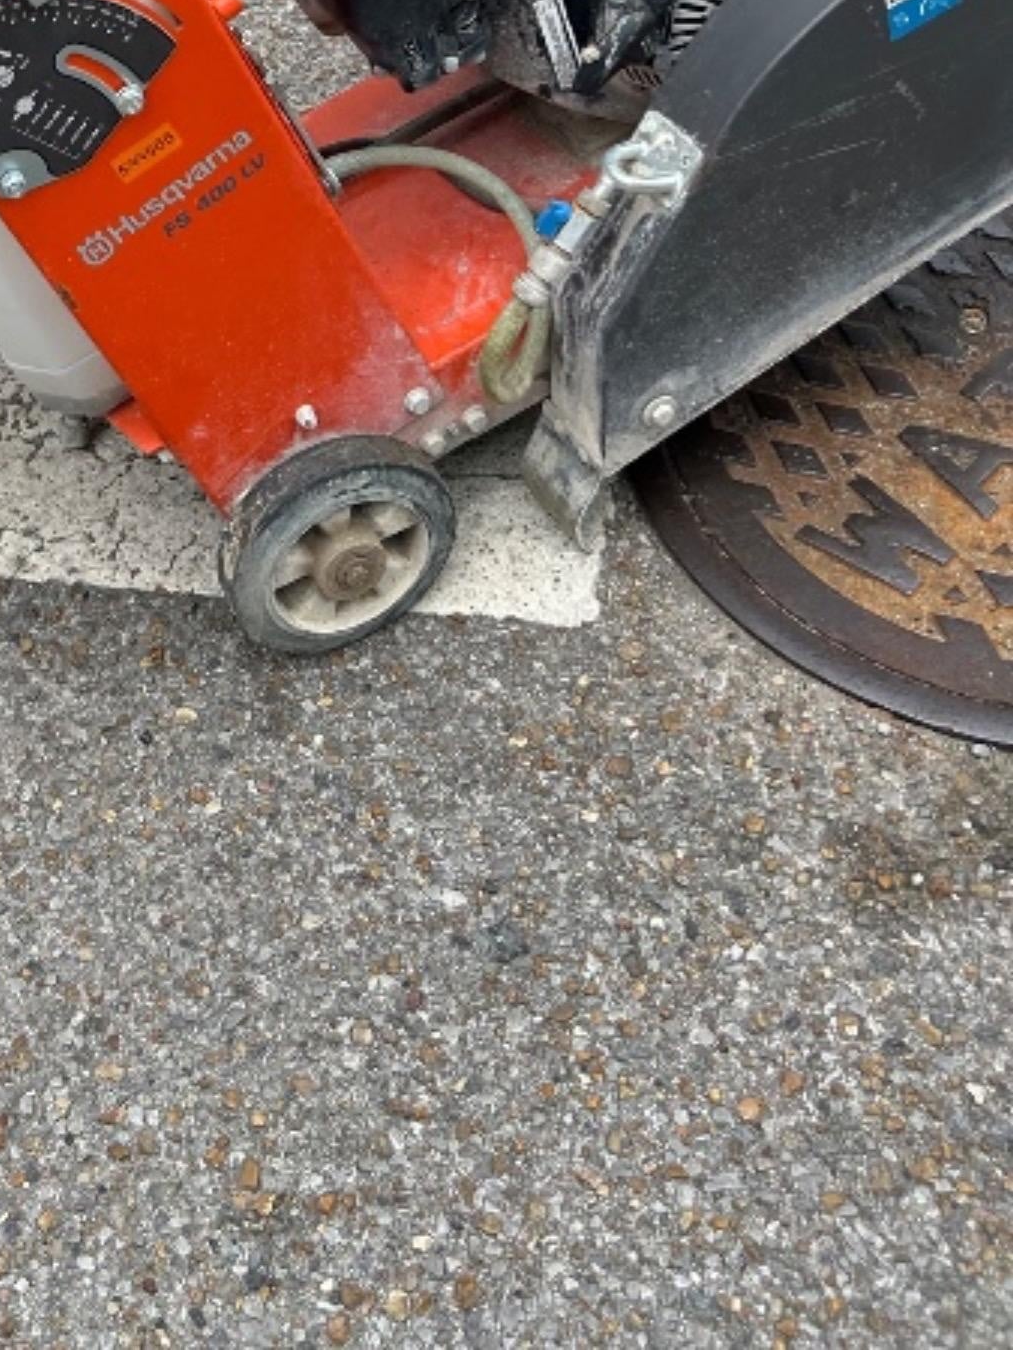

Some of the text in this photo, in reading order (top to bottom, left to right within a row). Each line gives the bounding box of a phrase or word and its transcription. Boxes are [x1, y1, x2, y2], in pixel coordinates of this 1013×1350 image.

[106, 130, 253, 244] Husqvarna
[163, 153, 266, 238] FS 400 LV
